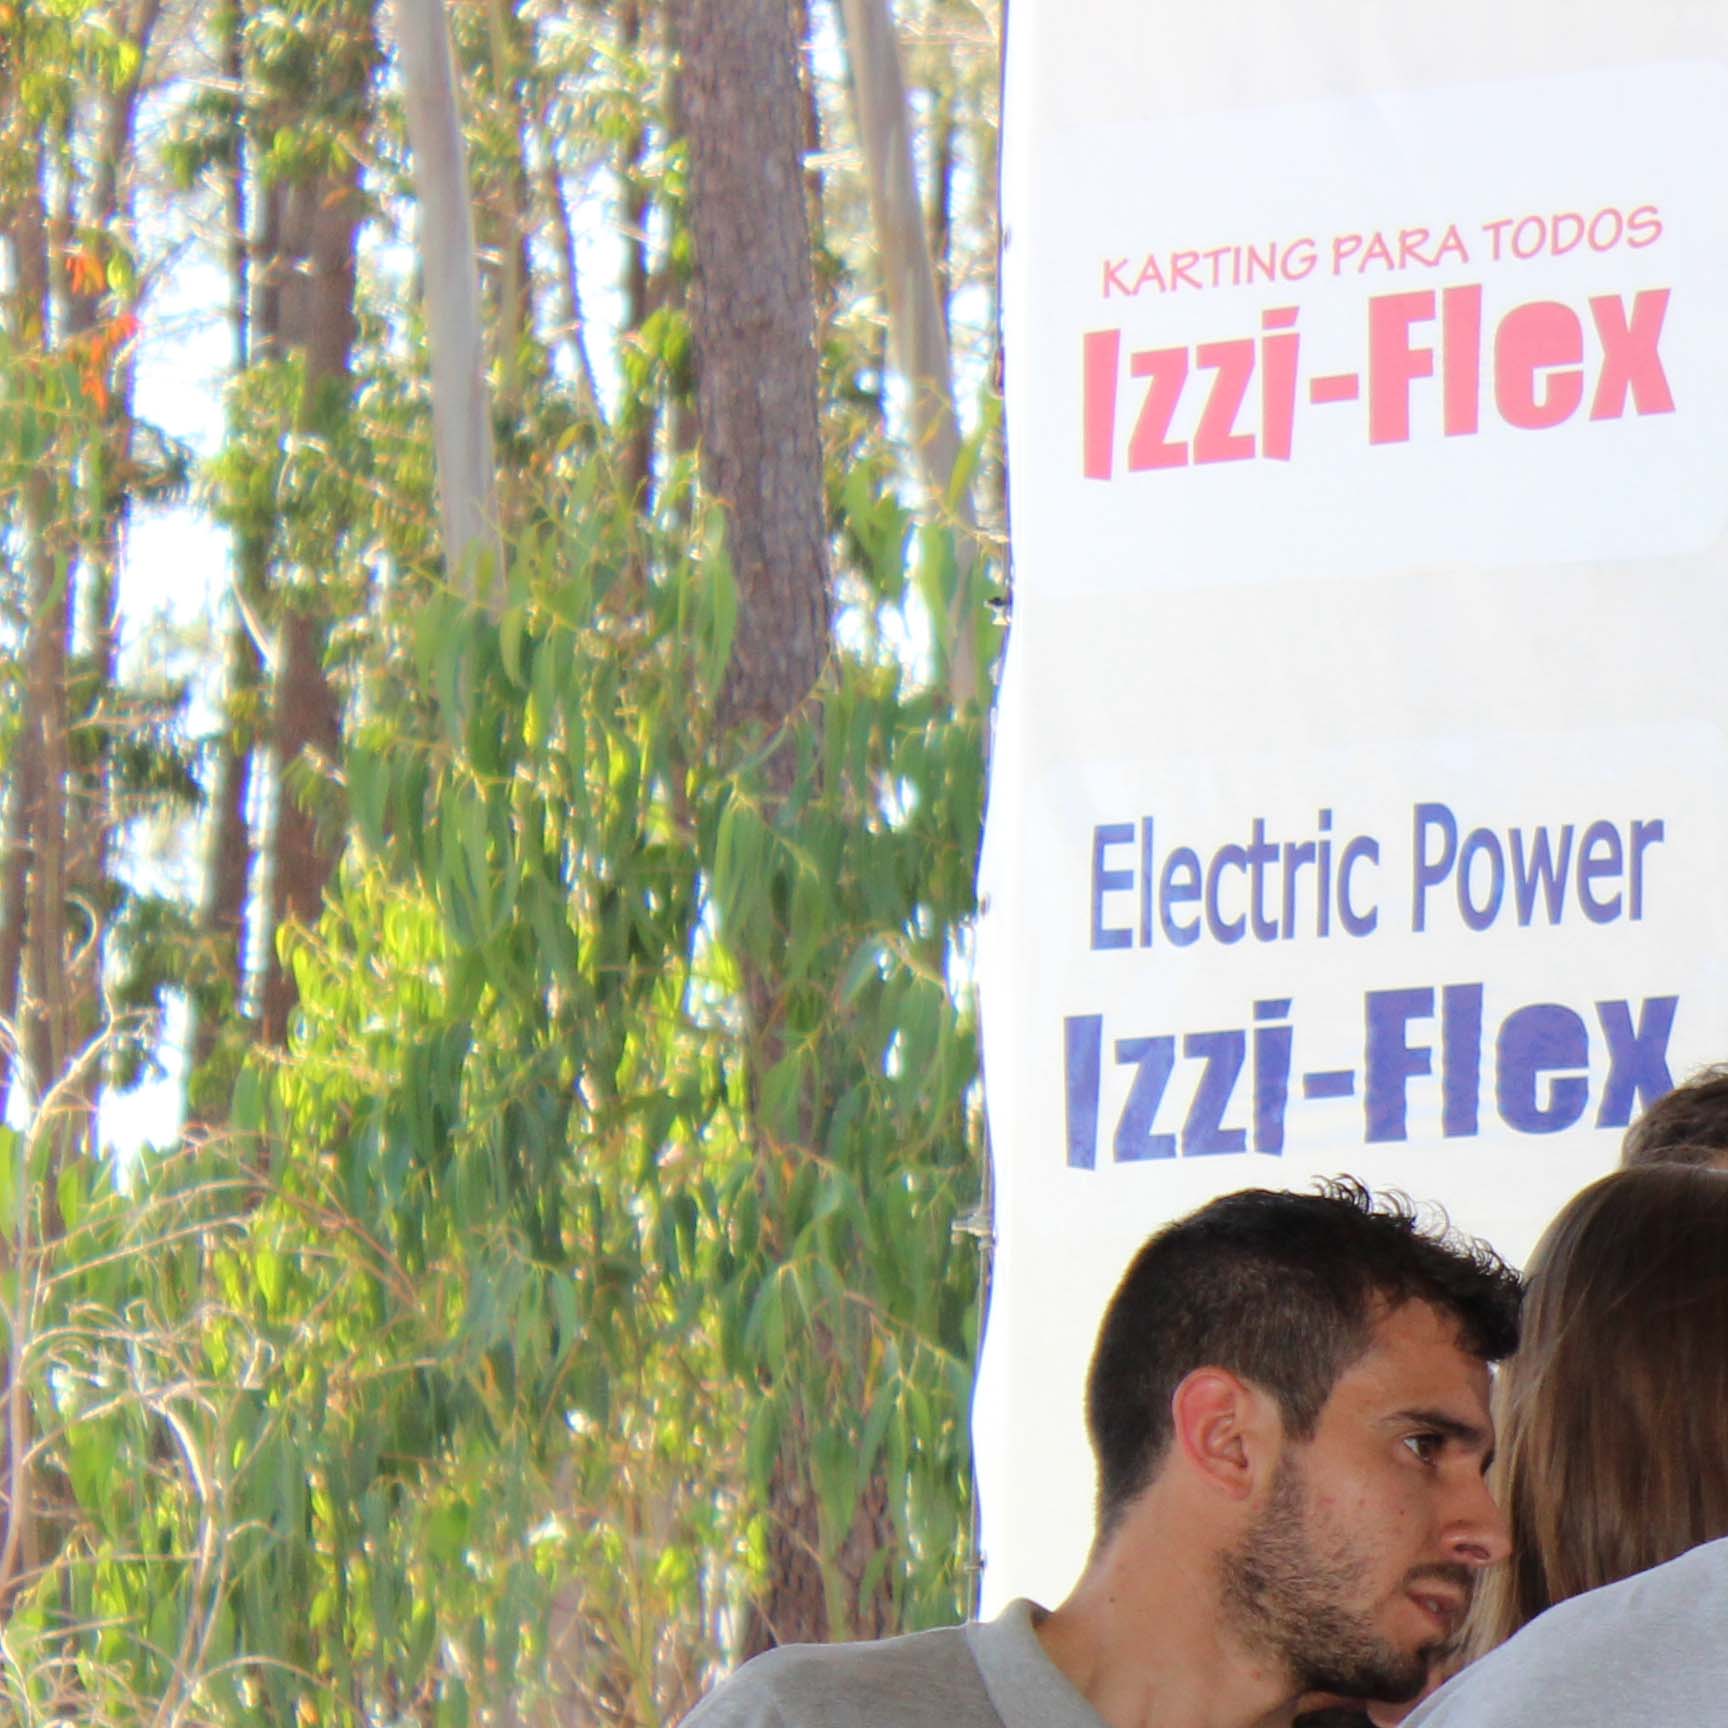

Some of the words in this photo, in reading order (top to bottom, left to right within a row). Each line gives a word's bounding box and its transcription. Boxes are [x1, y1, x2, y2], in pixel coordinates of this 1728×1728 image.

[1102, 238, 1318, 299] KARTING
[1332, 225, 1469, 276] PARA
[1482, 205, 1663, 261] TODOS
[1083, 283, 1676, 481] Izzi-Flex
[1091, 808, 1380, 950] Electric
[1411, 802, 1664, 933] Power
[1063, 982, 1680, 1171] Izzi-Flex
